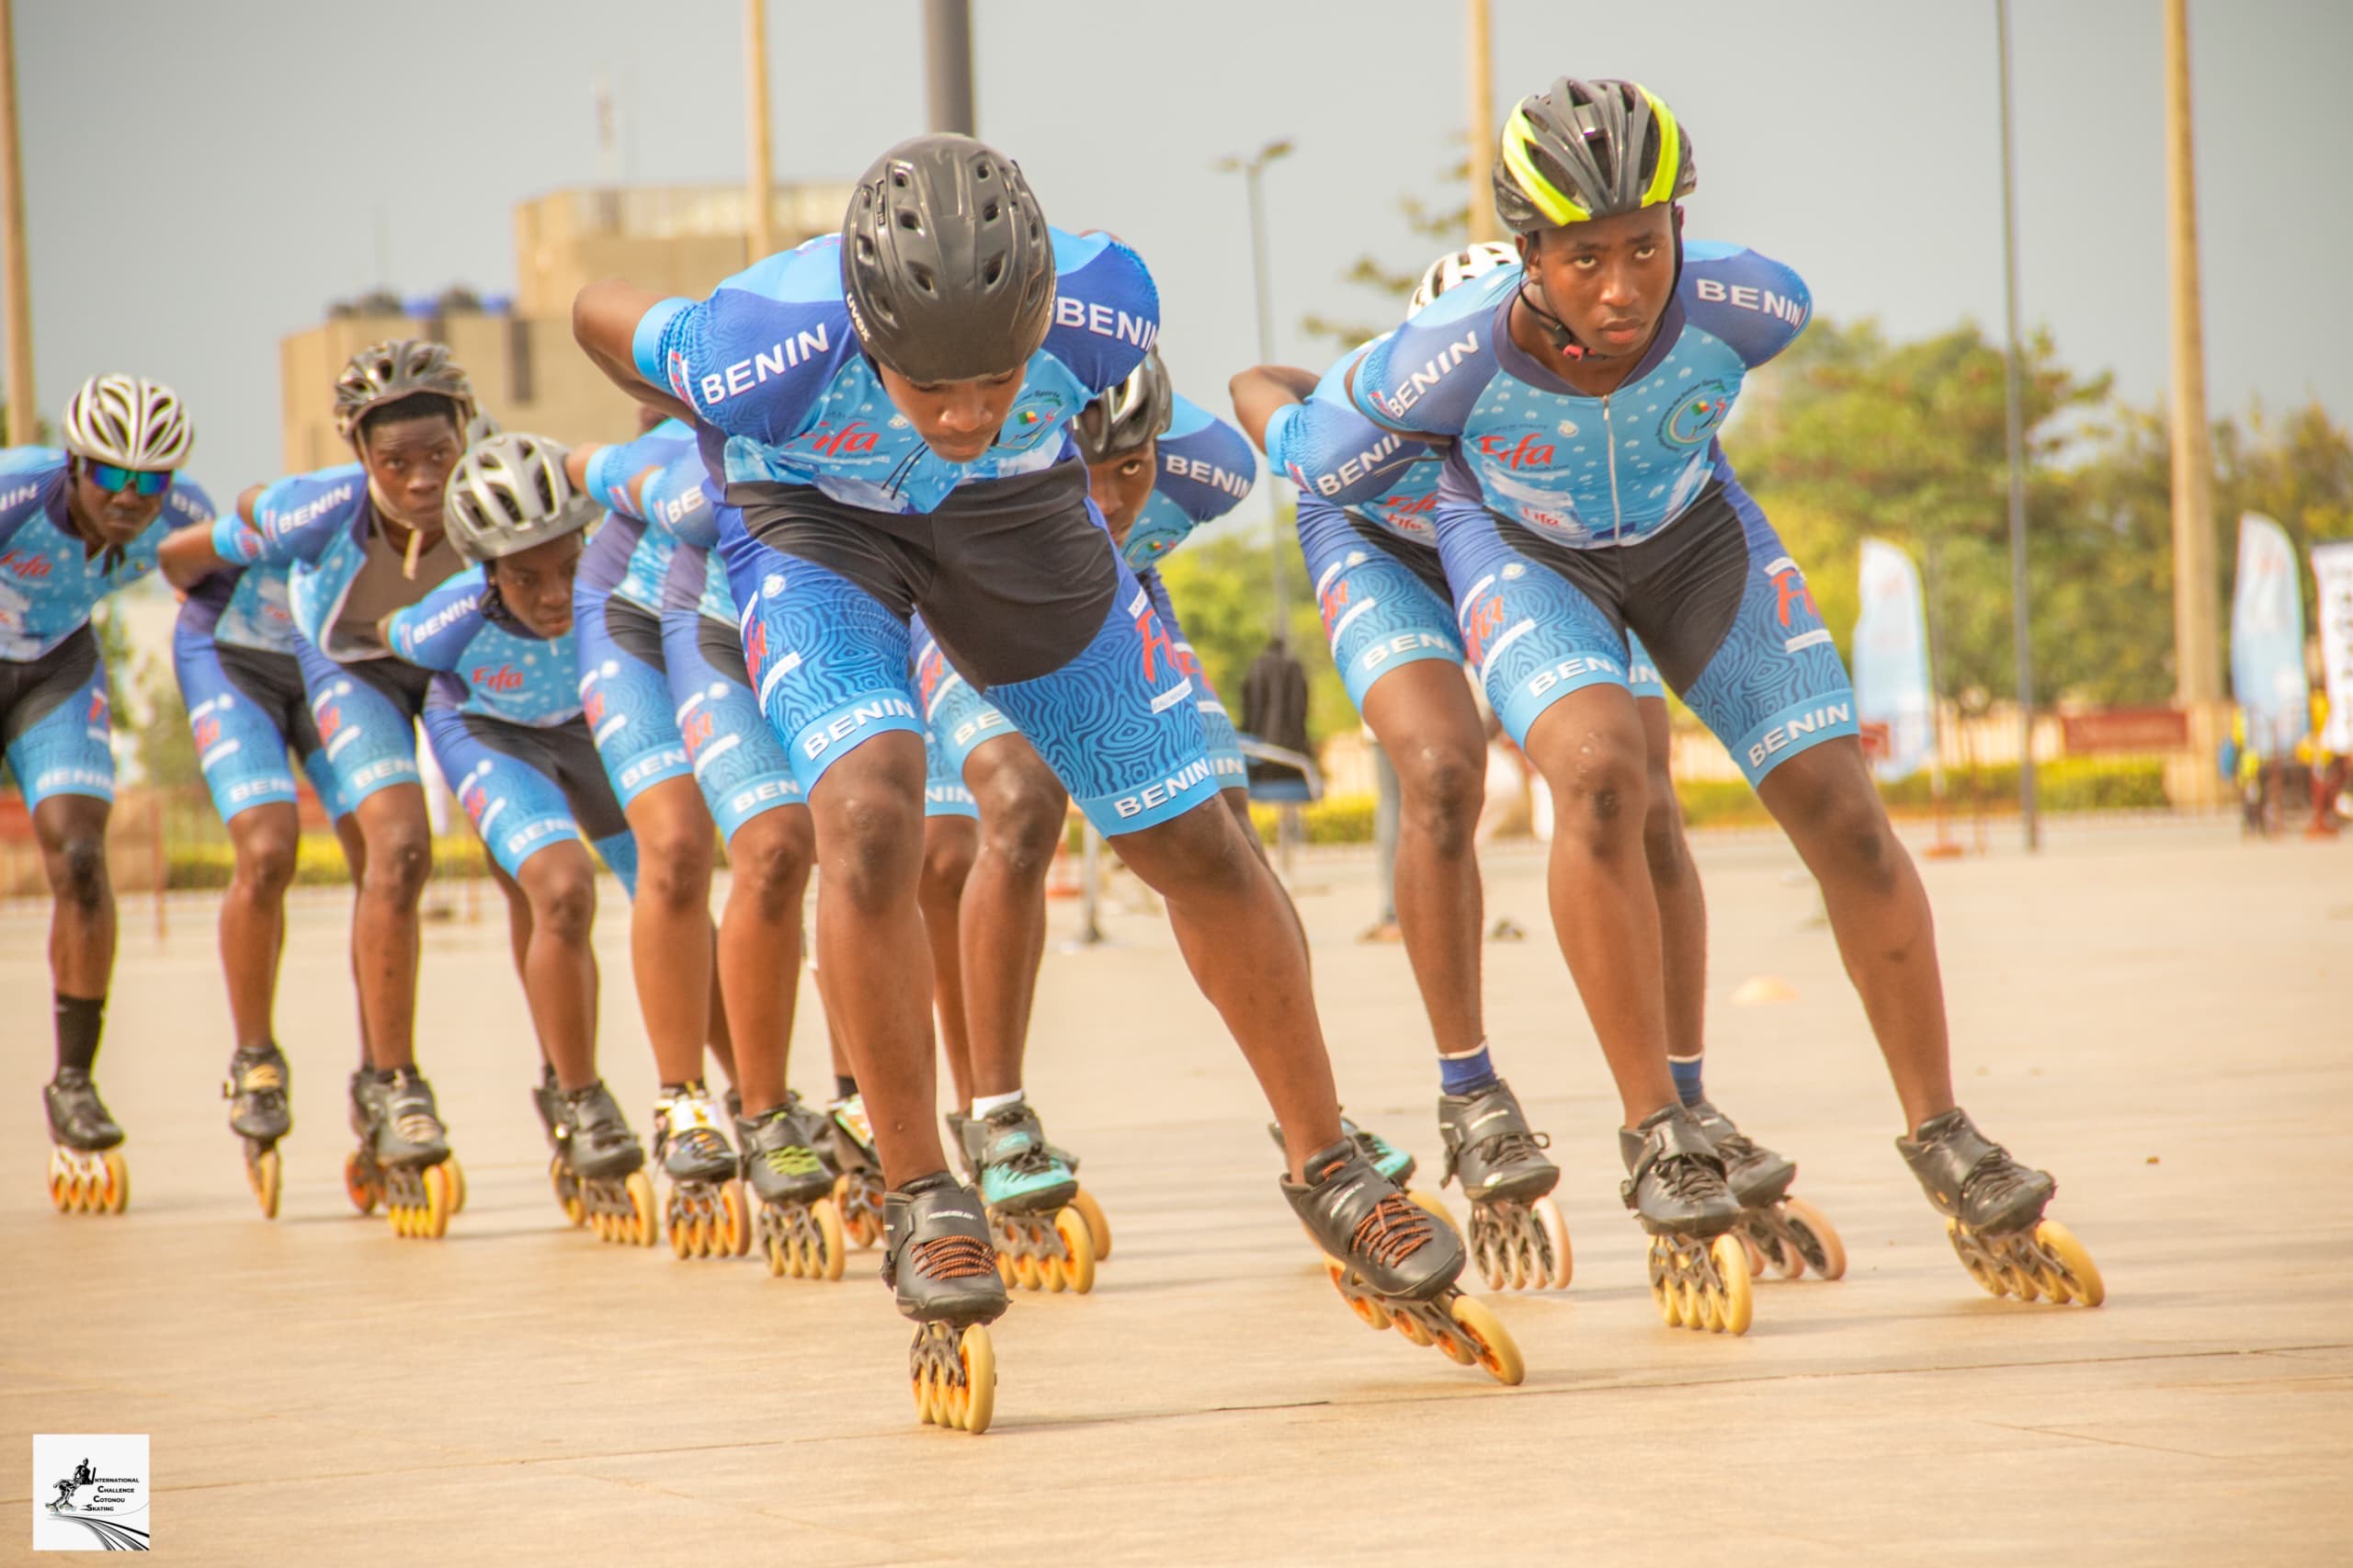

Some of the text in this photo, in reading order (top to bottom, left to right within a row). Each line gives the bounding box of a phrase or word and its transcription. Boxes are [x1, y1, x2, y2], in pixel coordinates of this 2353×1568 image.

[846, 291, 871, 342] uvex
[700, 323, 830, 406] BENIN
[1388, 330, 1480, 419] BENIN
[278, 484, 353, 535] BENIN
[413, 595, 477, 645] BENIN
[801, 698, 916, 761] BENIN
[1747, 702, 1850, 768] BENIN
[1114, 756, 1211, 819] BENIN
